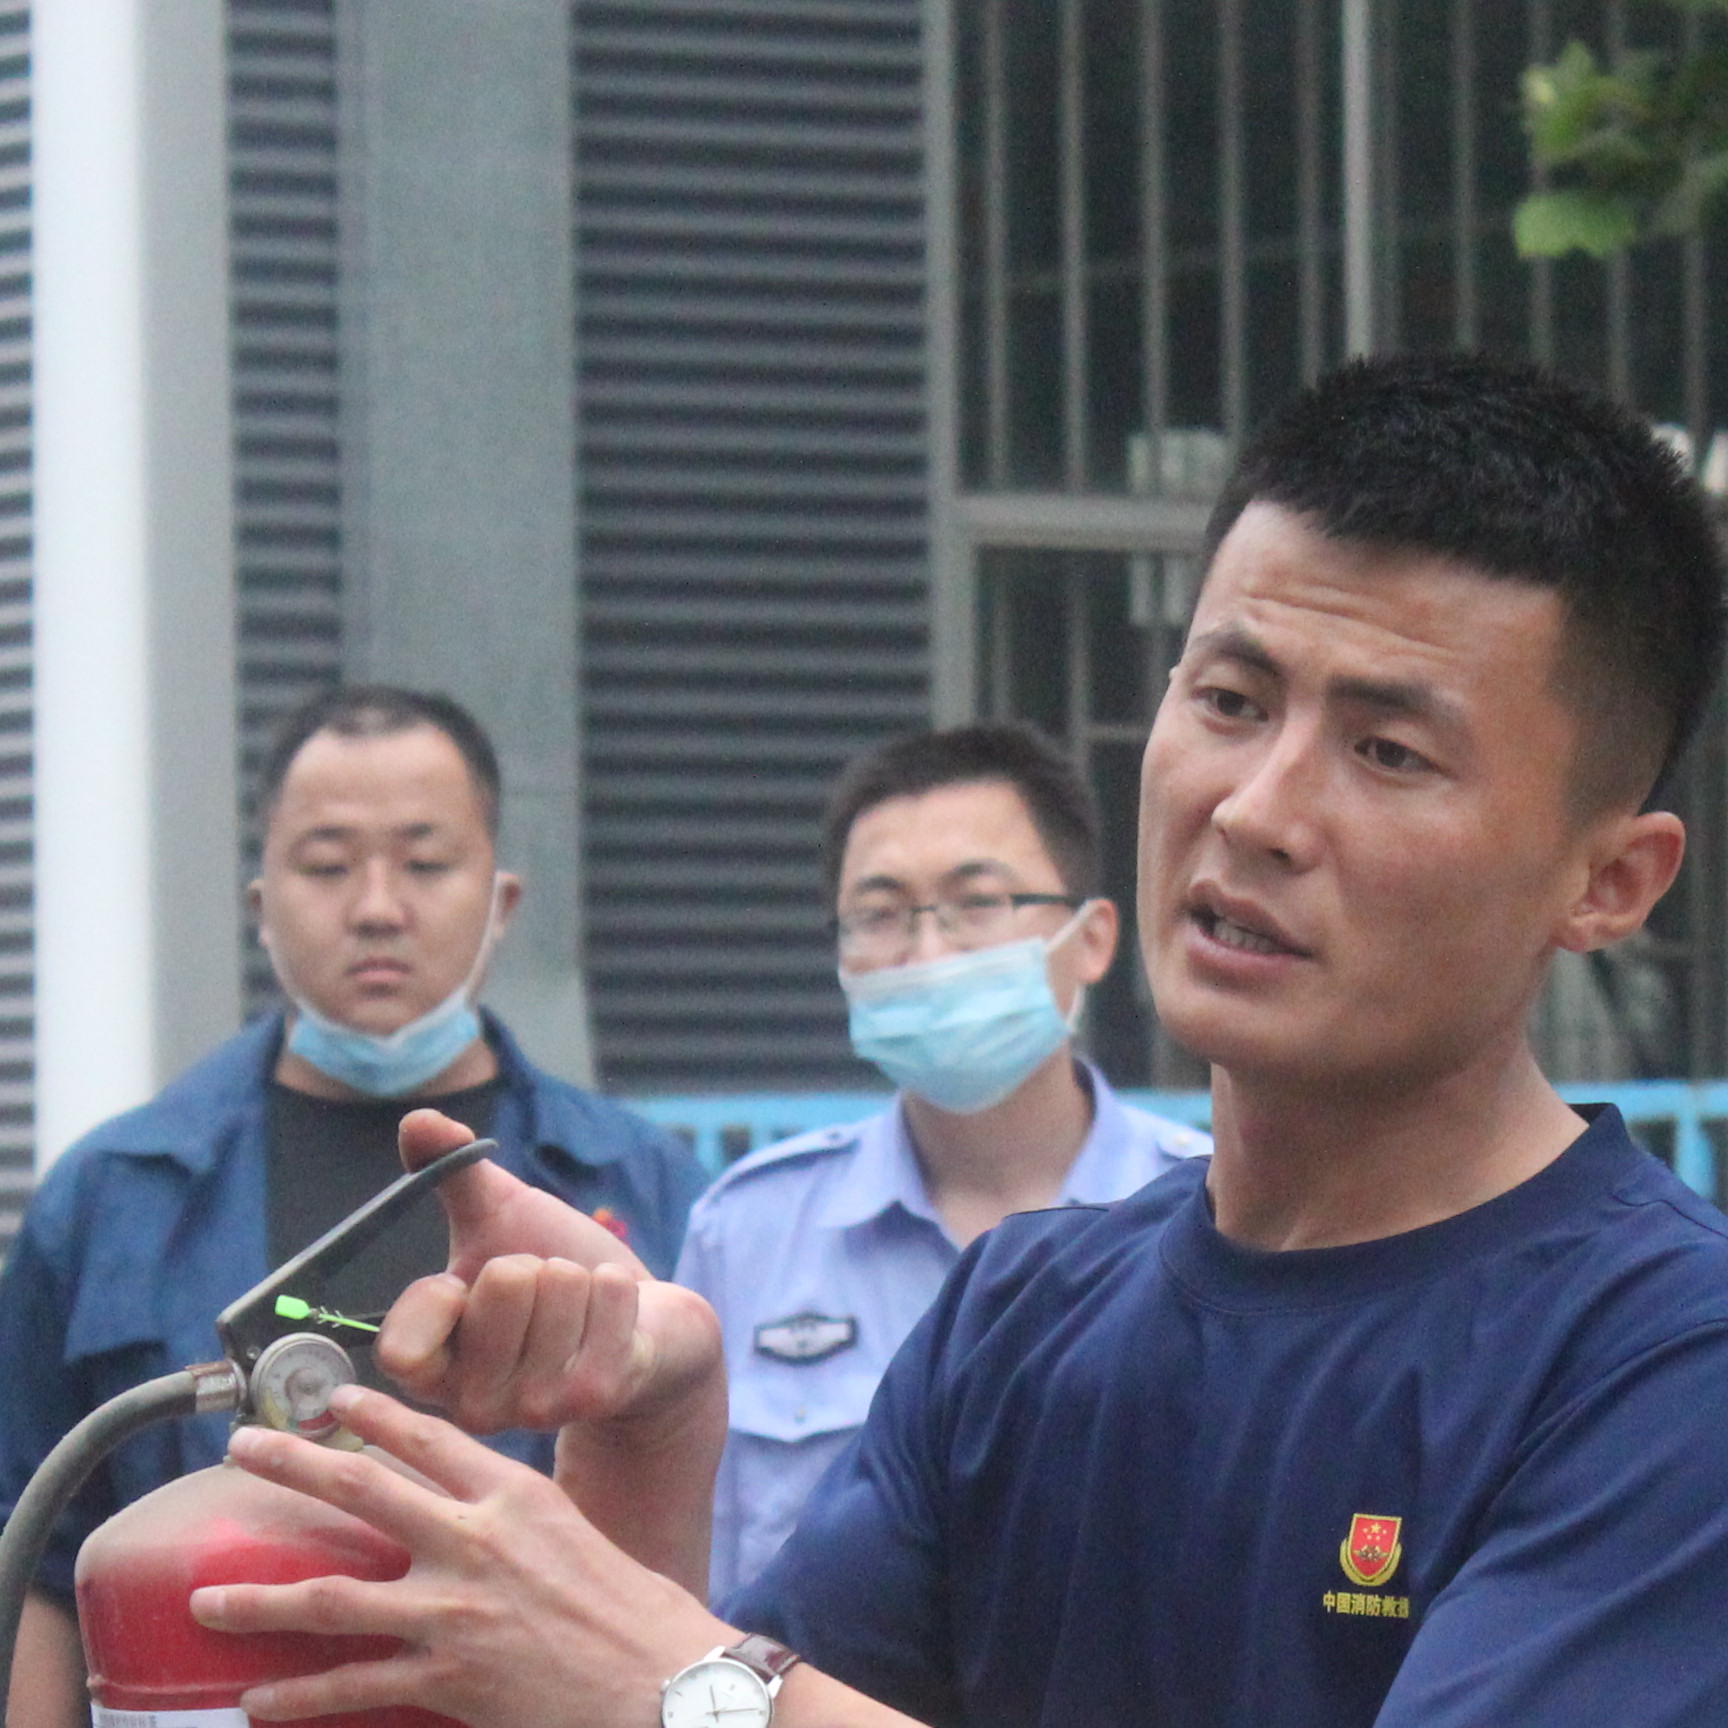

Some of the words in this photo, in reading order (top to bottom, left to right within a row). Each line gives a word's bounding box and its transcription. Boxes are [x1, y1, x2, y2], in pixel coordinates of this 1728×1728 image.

[1322, 1589, 1410, 1619] 中国消防救援
